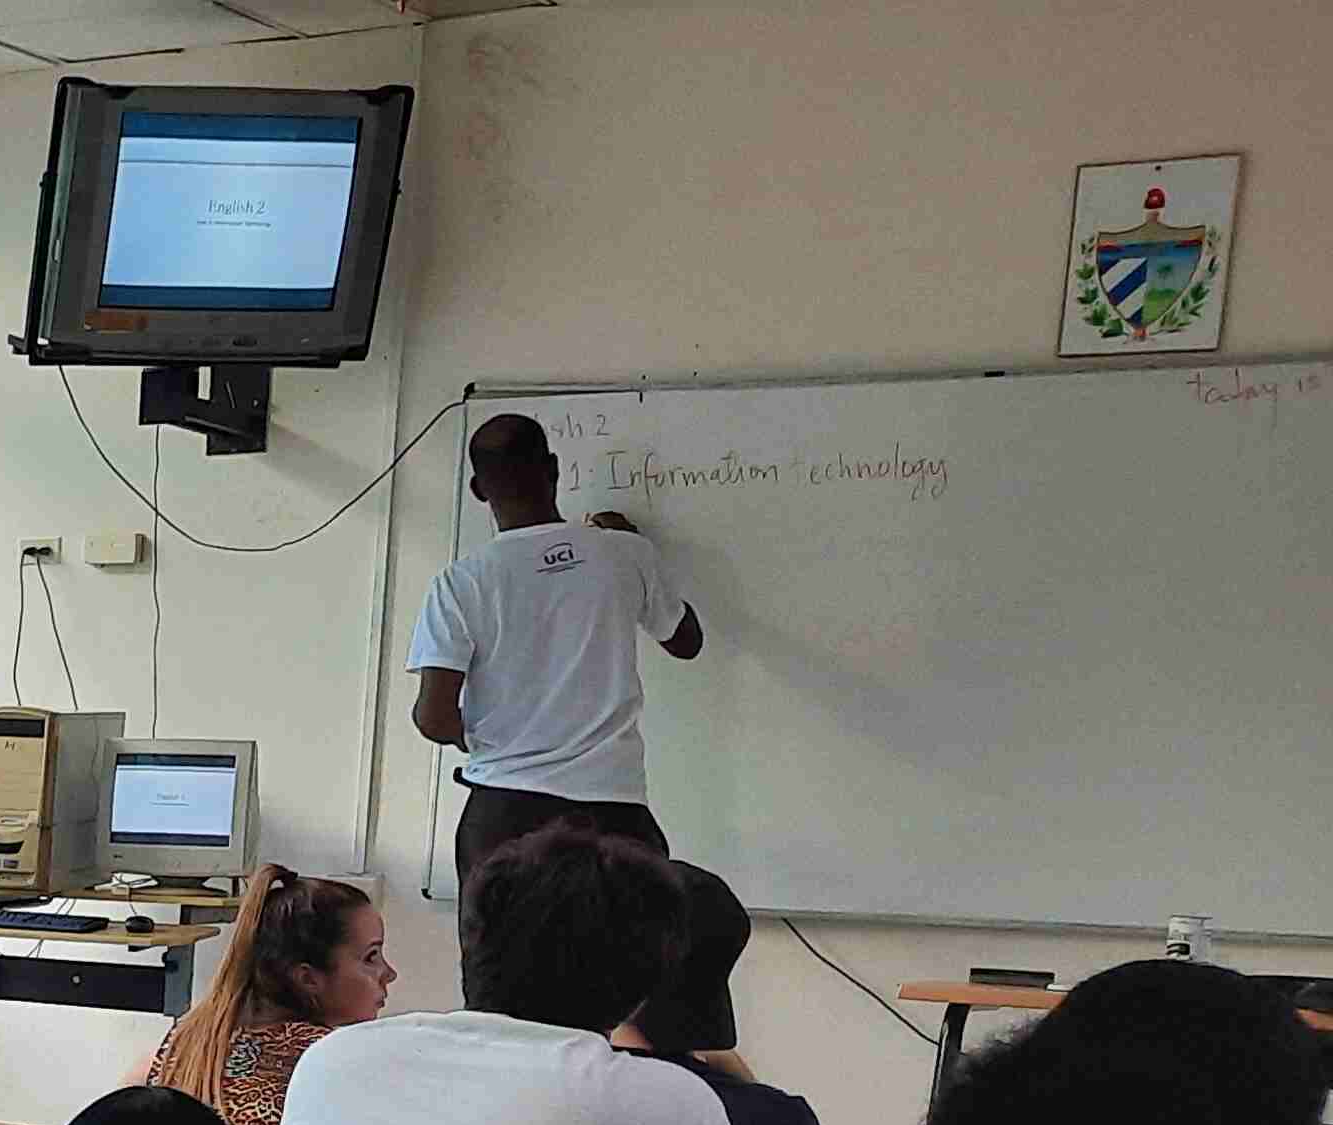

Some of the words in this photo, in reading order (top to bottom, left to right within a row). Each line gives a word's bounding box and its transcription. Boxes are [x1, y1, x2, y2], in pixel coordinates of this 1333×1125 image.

[207, 199, 254, 216] English
[255, 200, 269, 215] 2
[596, 413, 611, 436] 2
[606, 447, 781, 512] Information
[544, 549, 574, 565] UCI
